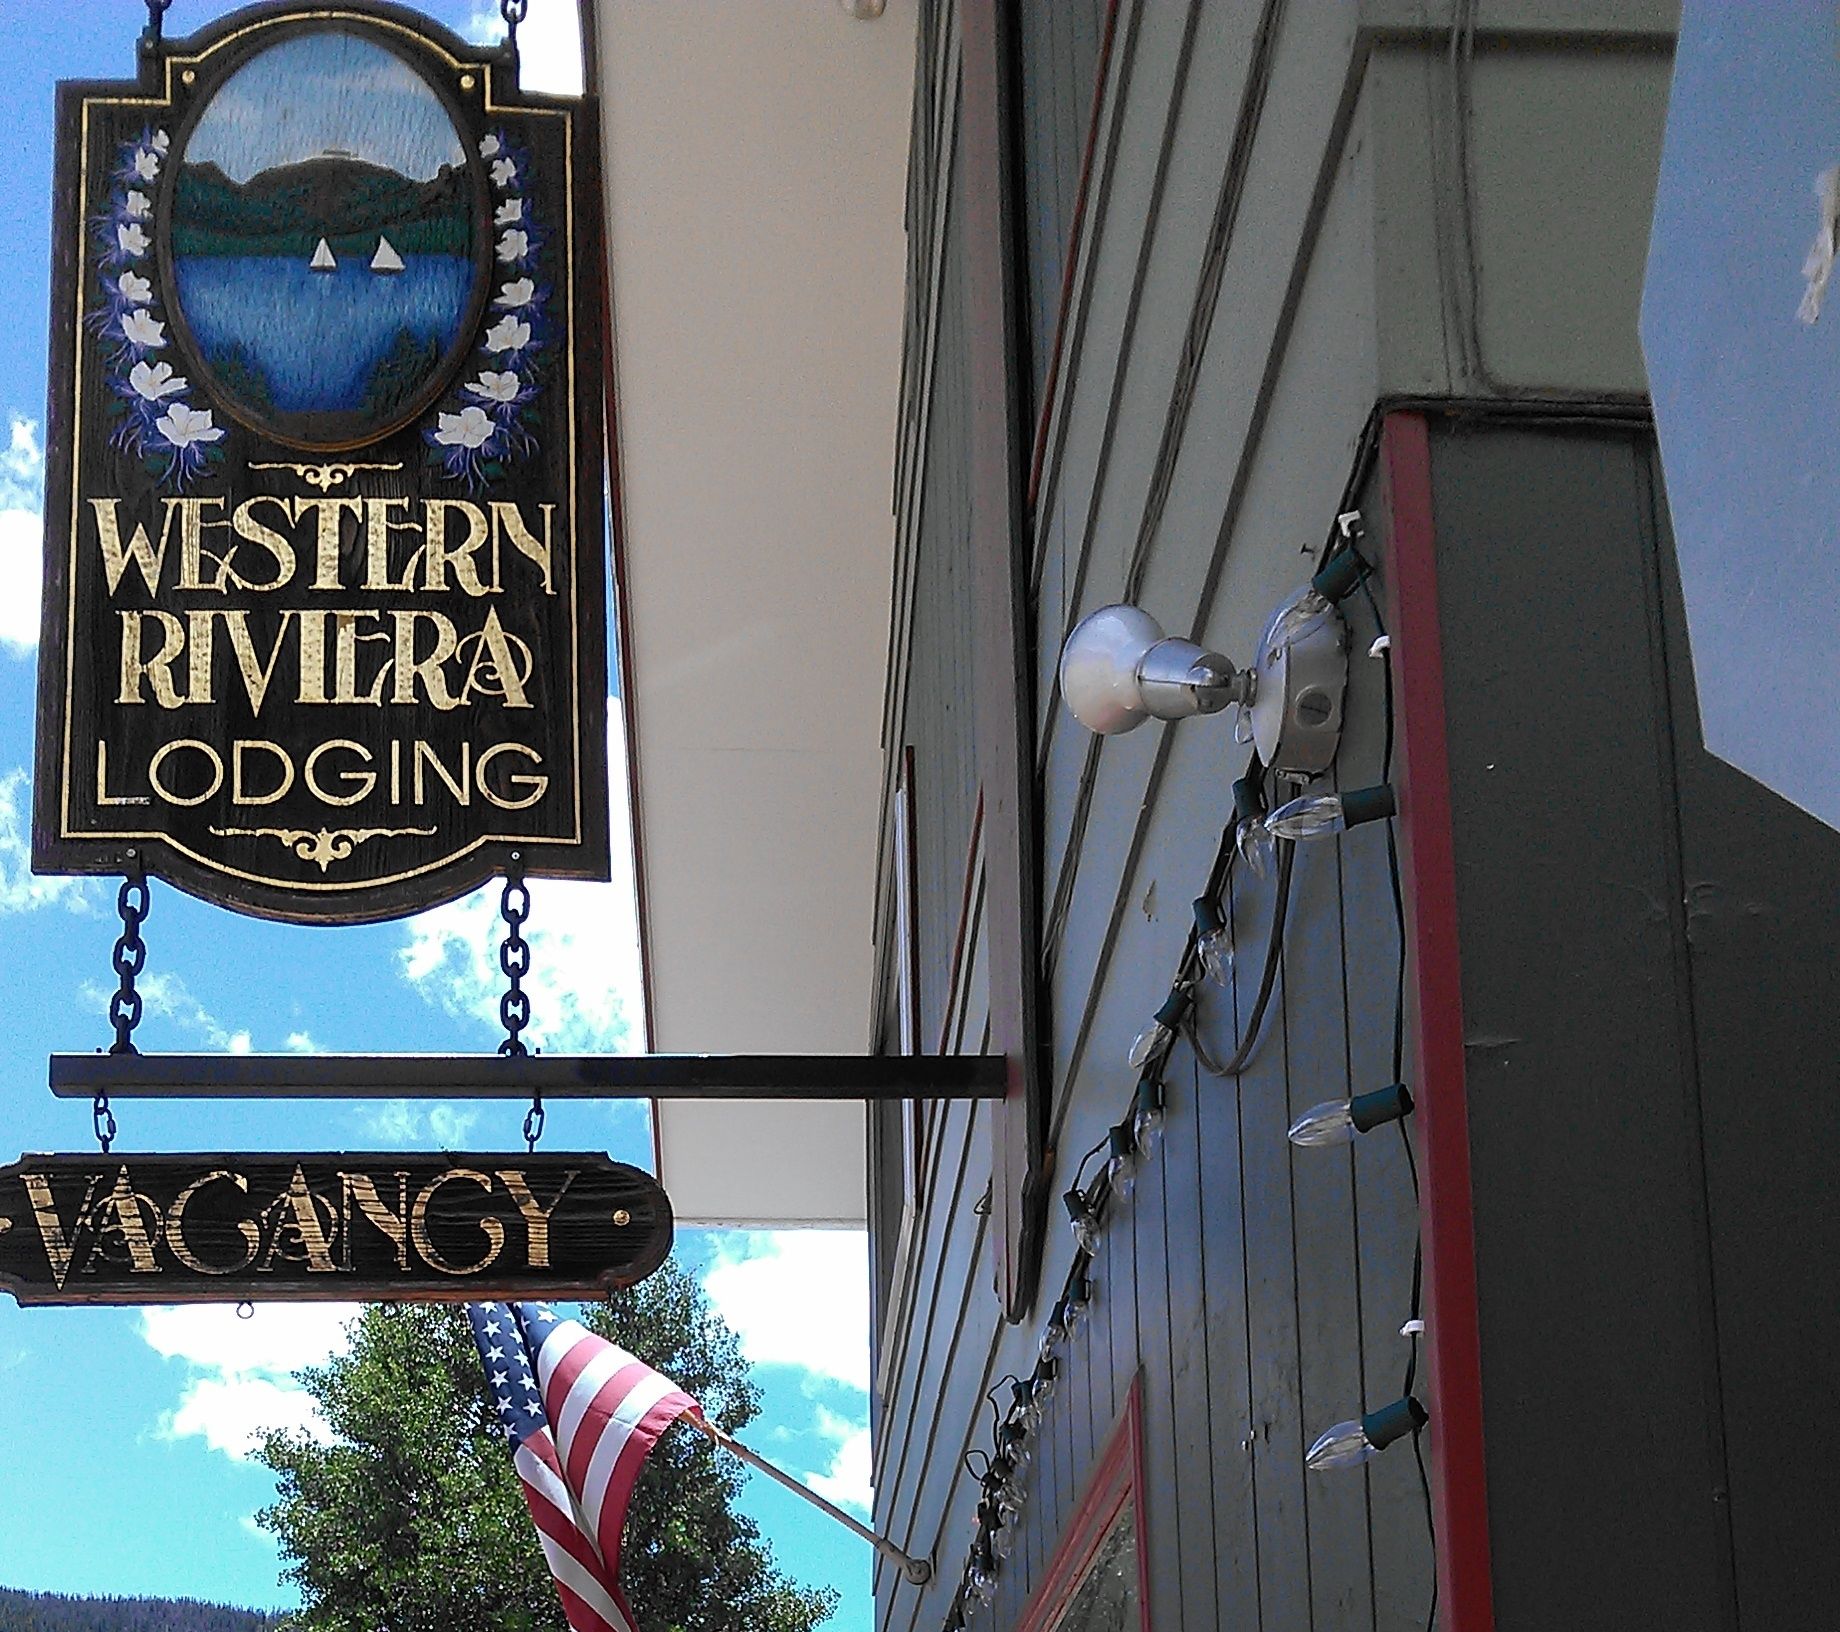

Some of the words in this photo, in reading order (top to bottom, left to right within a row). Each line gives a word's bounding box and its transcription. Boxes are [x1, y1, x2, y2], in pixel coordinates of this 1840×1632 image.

[87, 495, 557, 598] WESTERN
[114, 605, 535, 718] RIVIERA
[97, 739, 549, 809] LODGING
[20, 1164, 580, 1291] VACANCY
